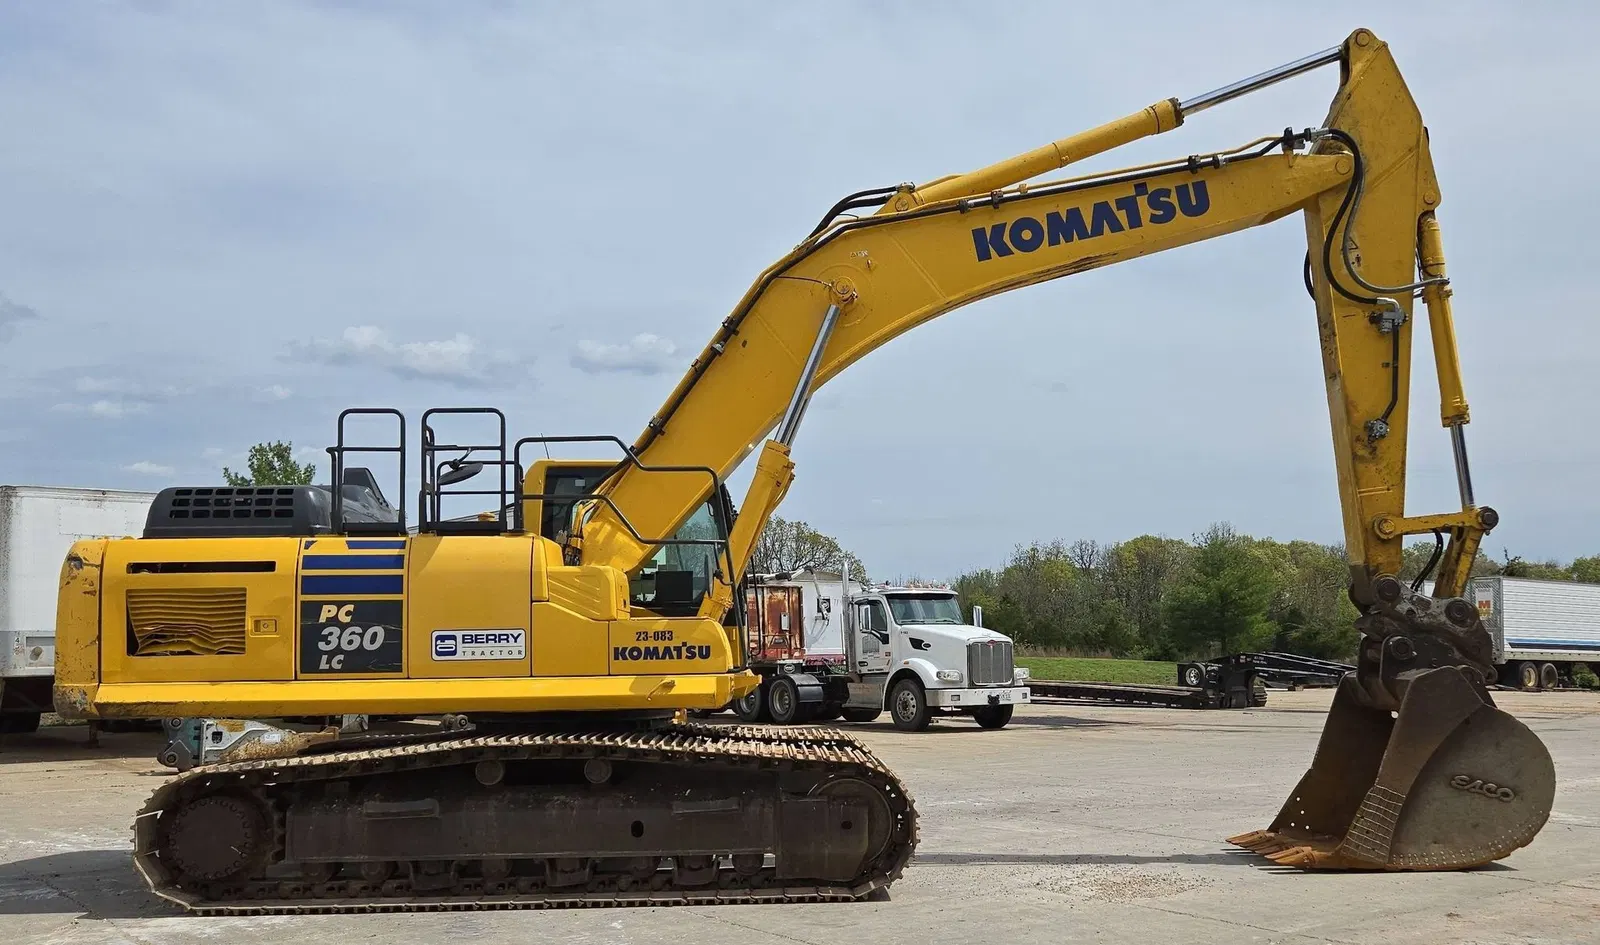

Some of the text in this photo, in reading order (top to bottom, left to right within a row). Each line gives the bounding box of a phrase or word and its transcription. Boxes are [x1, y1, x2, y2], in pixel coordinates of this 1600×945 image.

[971, 180, 1211, 262] KOMATSU
[318, 604, 355, 623] PC
[317, 626, 385, 651] 360
[461, 633, 523, 644] BERRY
[635, 630, 674, 642] 23-083
[613, 642, 711, 661] KOMATSU
[318, 654, 345, 670] LC
